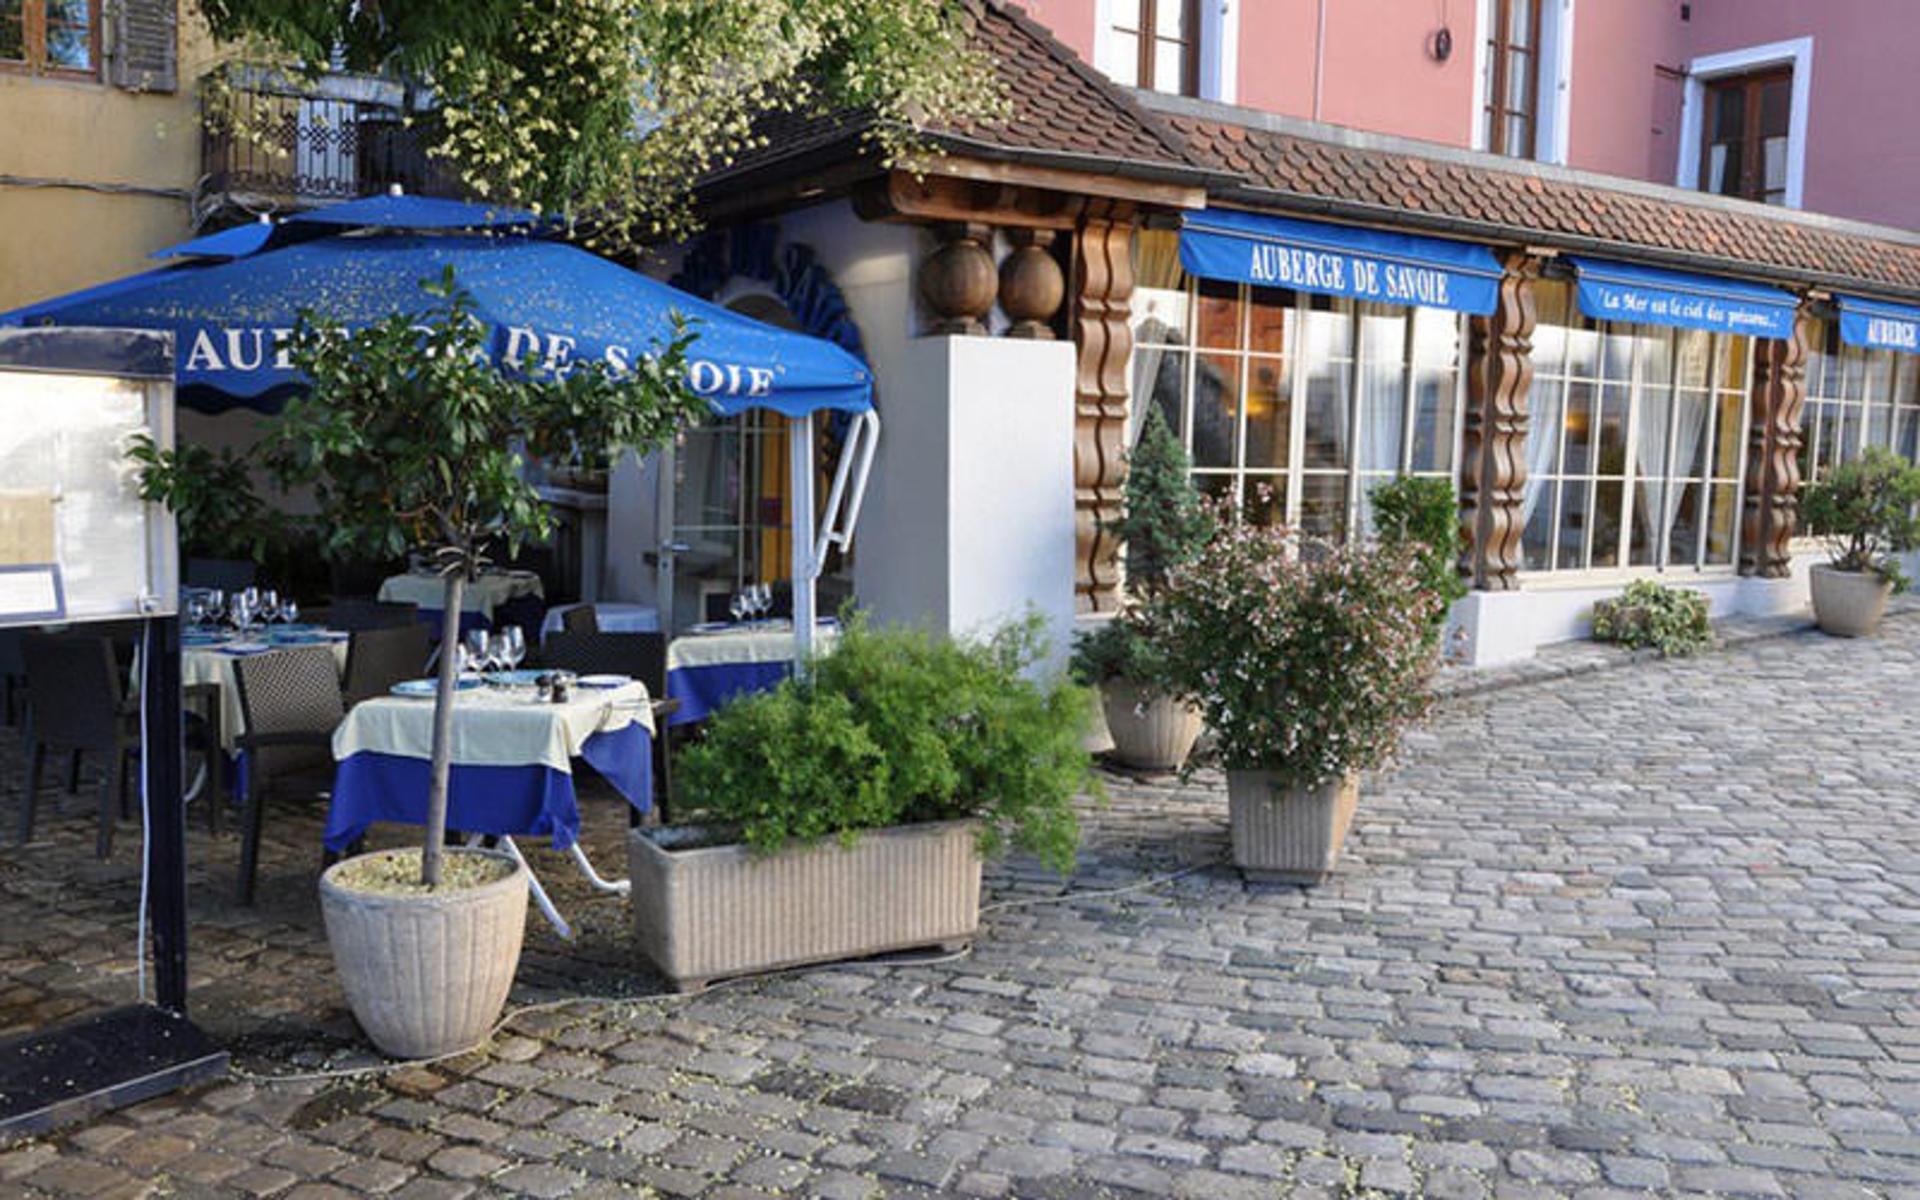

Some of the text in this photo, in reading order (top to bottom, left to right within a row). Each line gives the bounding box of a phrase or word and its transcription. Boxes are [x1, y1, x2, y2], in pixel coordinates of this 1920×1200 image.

[1250, 244, 1449, 304] AUBERGE DE SAVOIE
[502, 326, 575, 374] DE
[604, 345, 775, 398] SOIE
